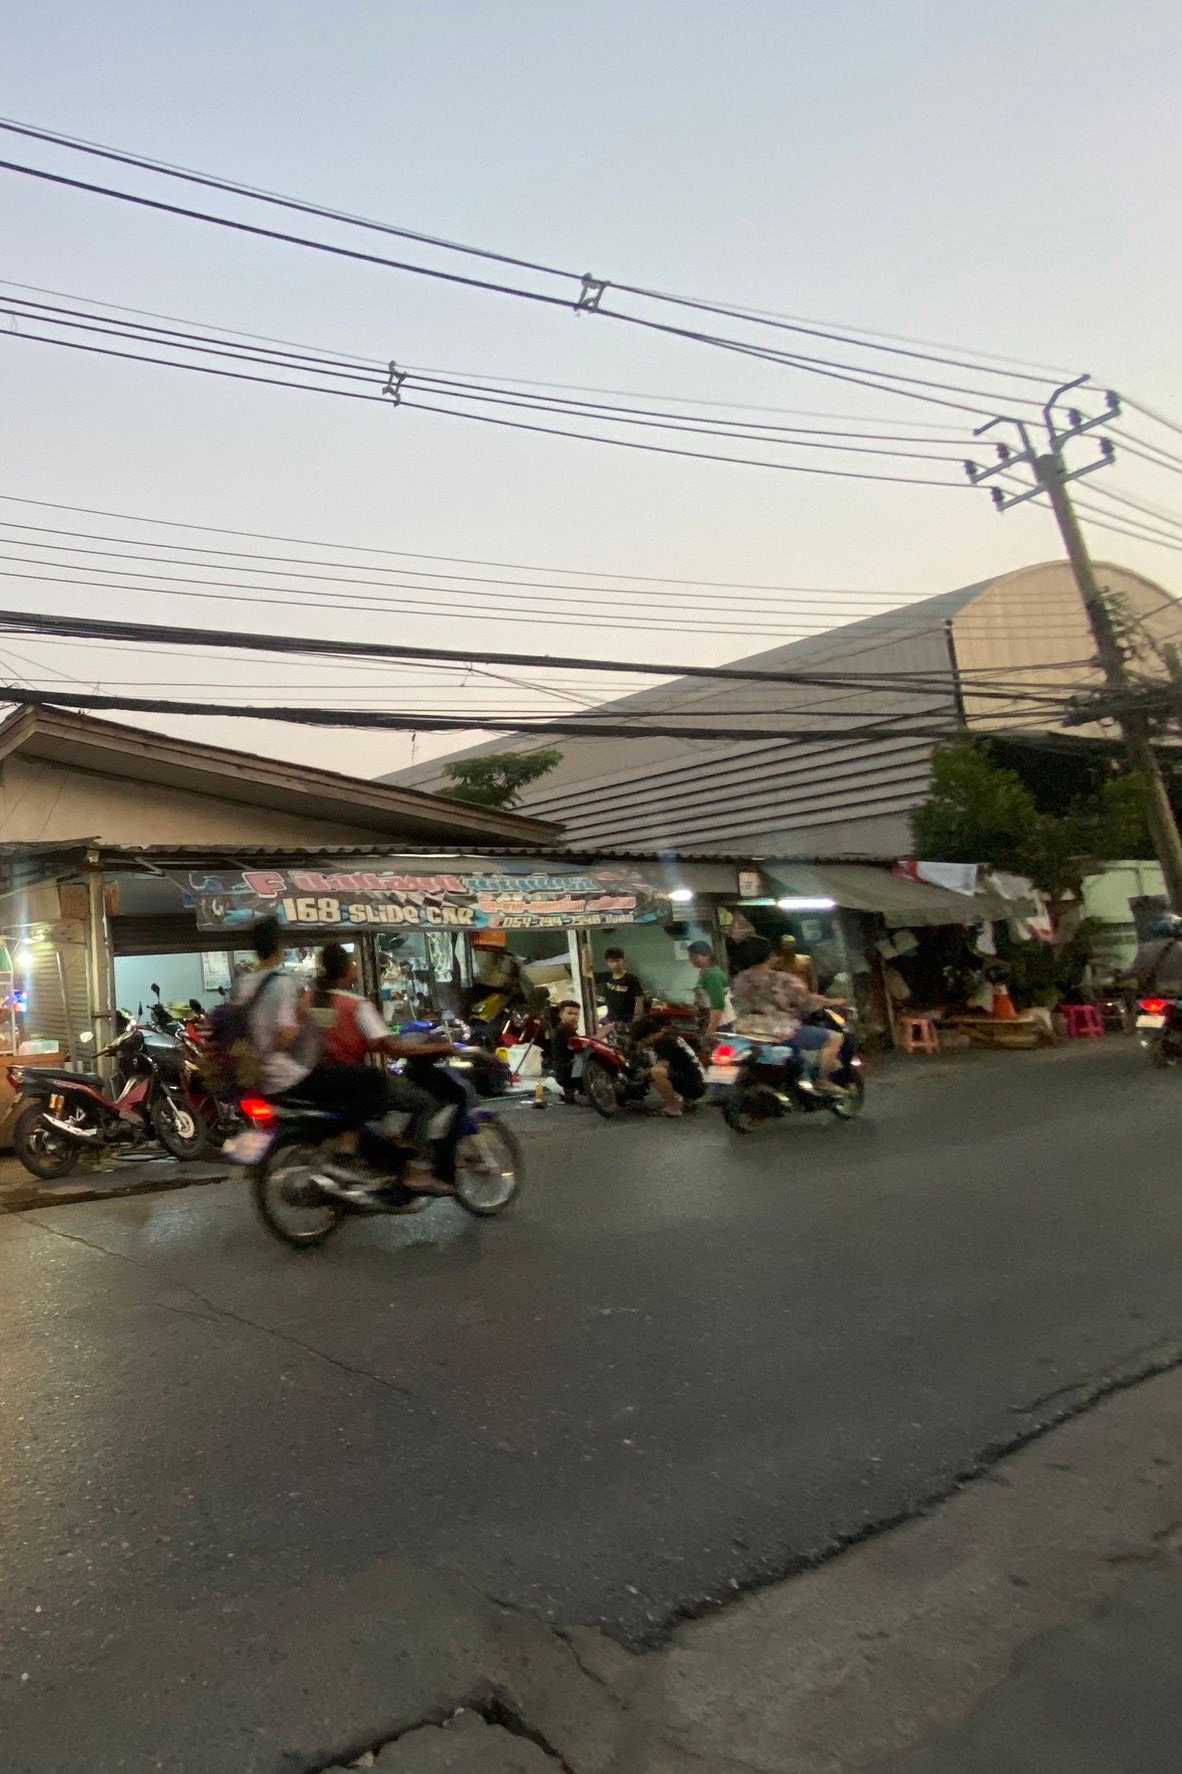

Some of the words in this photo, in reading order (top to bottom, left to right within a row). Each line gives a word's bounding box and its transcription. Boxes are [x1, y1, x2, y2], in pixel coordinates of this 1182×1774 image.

[242, 871, 286, 898] F
[283, 897, 341, 922] 168
[426, 906, 474, 925] CAR
